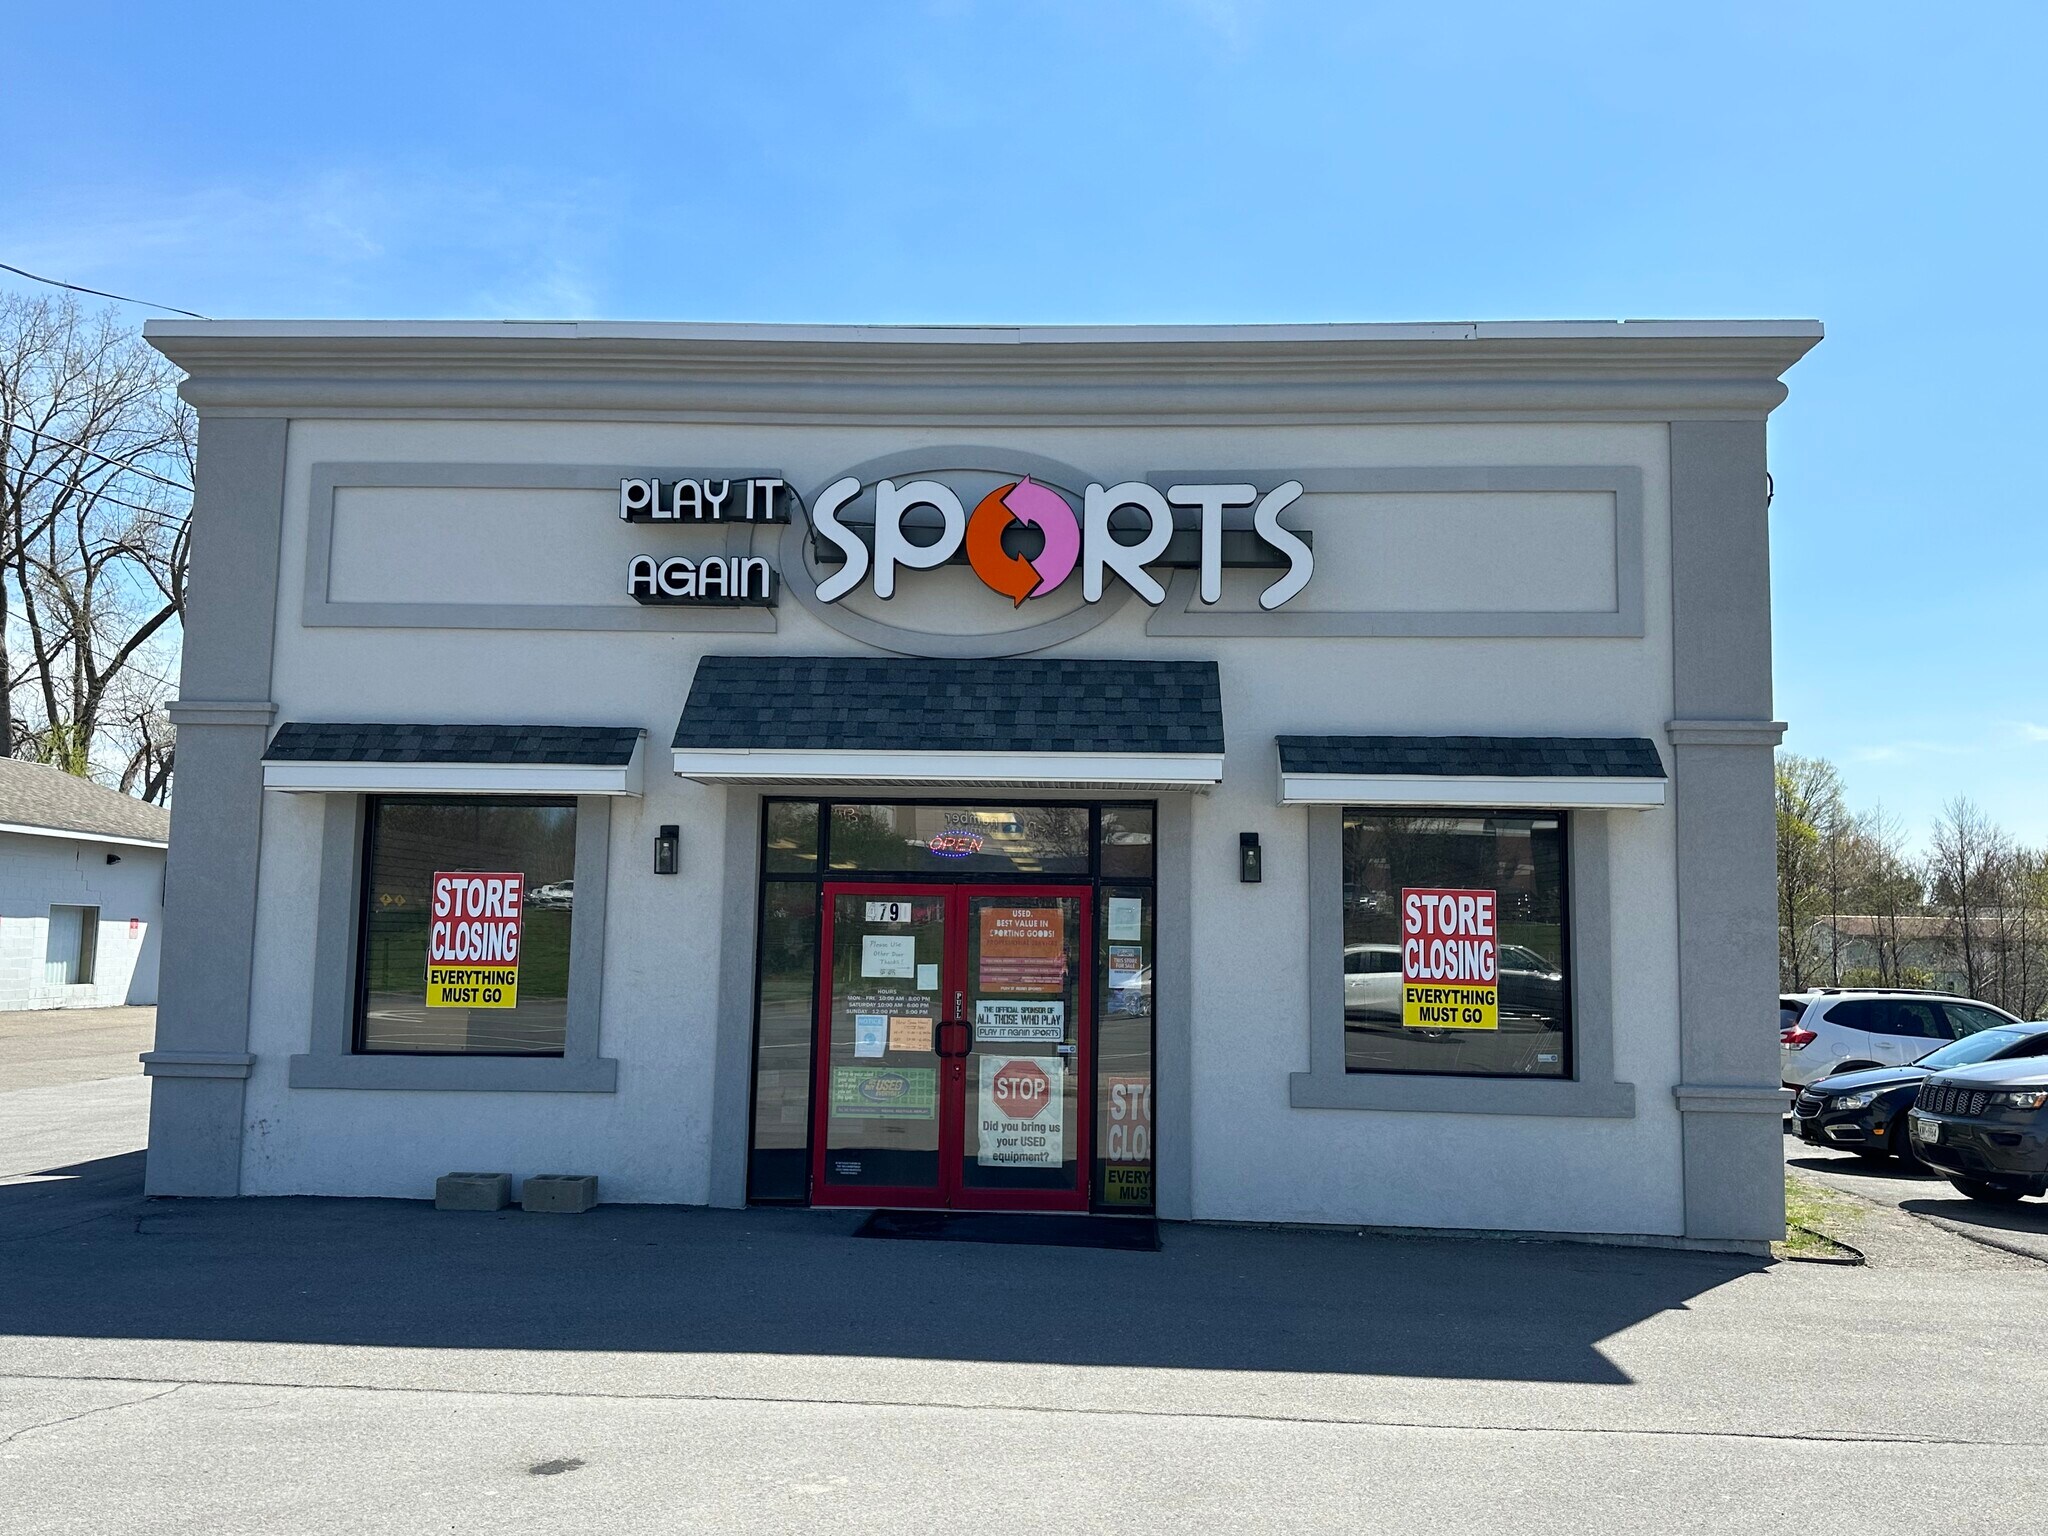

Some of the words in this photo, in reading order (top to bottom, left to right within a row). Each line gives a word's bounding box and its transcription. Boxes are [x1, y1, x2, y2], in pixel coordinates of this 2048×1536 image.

[620, 478, 730, 520] PLAY
[746, 479, 784, 520] IT
[812, 473, 1315, 610] SPORTS
[627, 554, 771, 599] AGAIN
[929, 837, 984, 852] OPEN
[435, 877, 520, 917] STORE
[996, 919, 1013, 927] BEST
[1014, 919, 1038, 927] VALUE
[1040, 919, 1049, 927] IN
[1405, 894, 1493, 936] STORE
[431, 921, 518, 962] CLOSING
[1405, 938, 1495, 981] CLOSING
[431, 970, 515, 986] EVERYTHING
[442, 987, 480, 1003] MUST
[482, 988, 502, 1003] GO
[1406, 988, 1495, 1006] EVERYTHING
[995, 1006, 1019, 1014] OFFICIAL
[1419, 1007, 1458, 1022] MUST
[1462, 1008, 1483, 1023] GO
[977, 1014, 991, 1025] ALL
[994, 1014, 1018, 1025] THOSE
[1021, 1014, 1039, 1025] WHO
[1041, 1014, 1062, 1026] PLAY
[980, 1028, 998, 1036] PLAY
[999, 1028, 1006, 1036] IT
[1007, 1028, 1031, 1036] AGAIN
[1032, 1029, 1059, 1037] SPORTS
[876, 1079, 904, 1091] USED
[996, 1077, 1046, 1100] STOP
[983, 1121, 999, 1132] Did
[1001, 1123, 1019, 1133] you
[1021, 1121, 1046, 1133] bring
[1049, 1124, 1060, 1133] us
[996, 1138, 1018, 1148] your
[1020, 1137, 1046, 1147] USED
[1109, 1124, 1151, 1161] CLO
[992, 1151, 1050, 1164] equipment?
[1120, 1186, 1151, 1200] MUS
